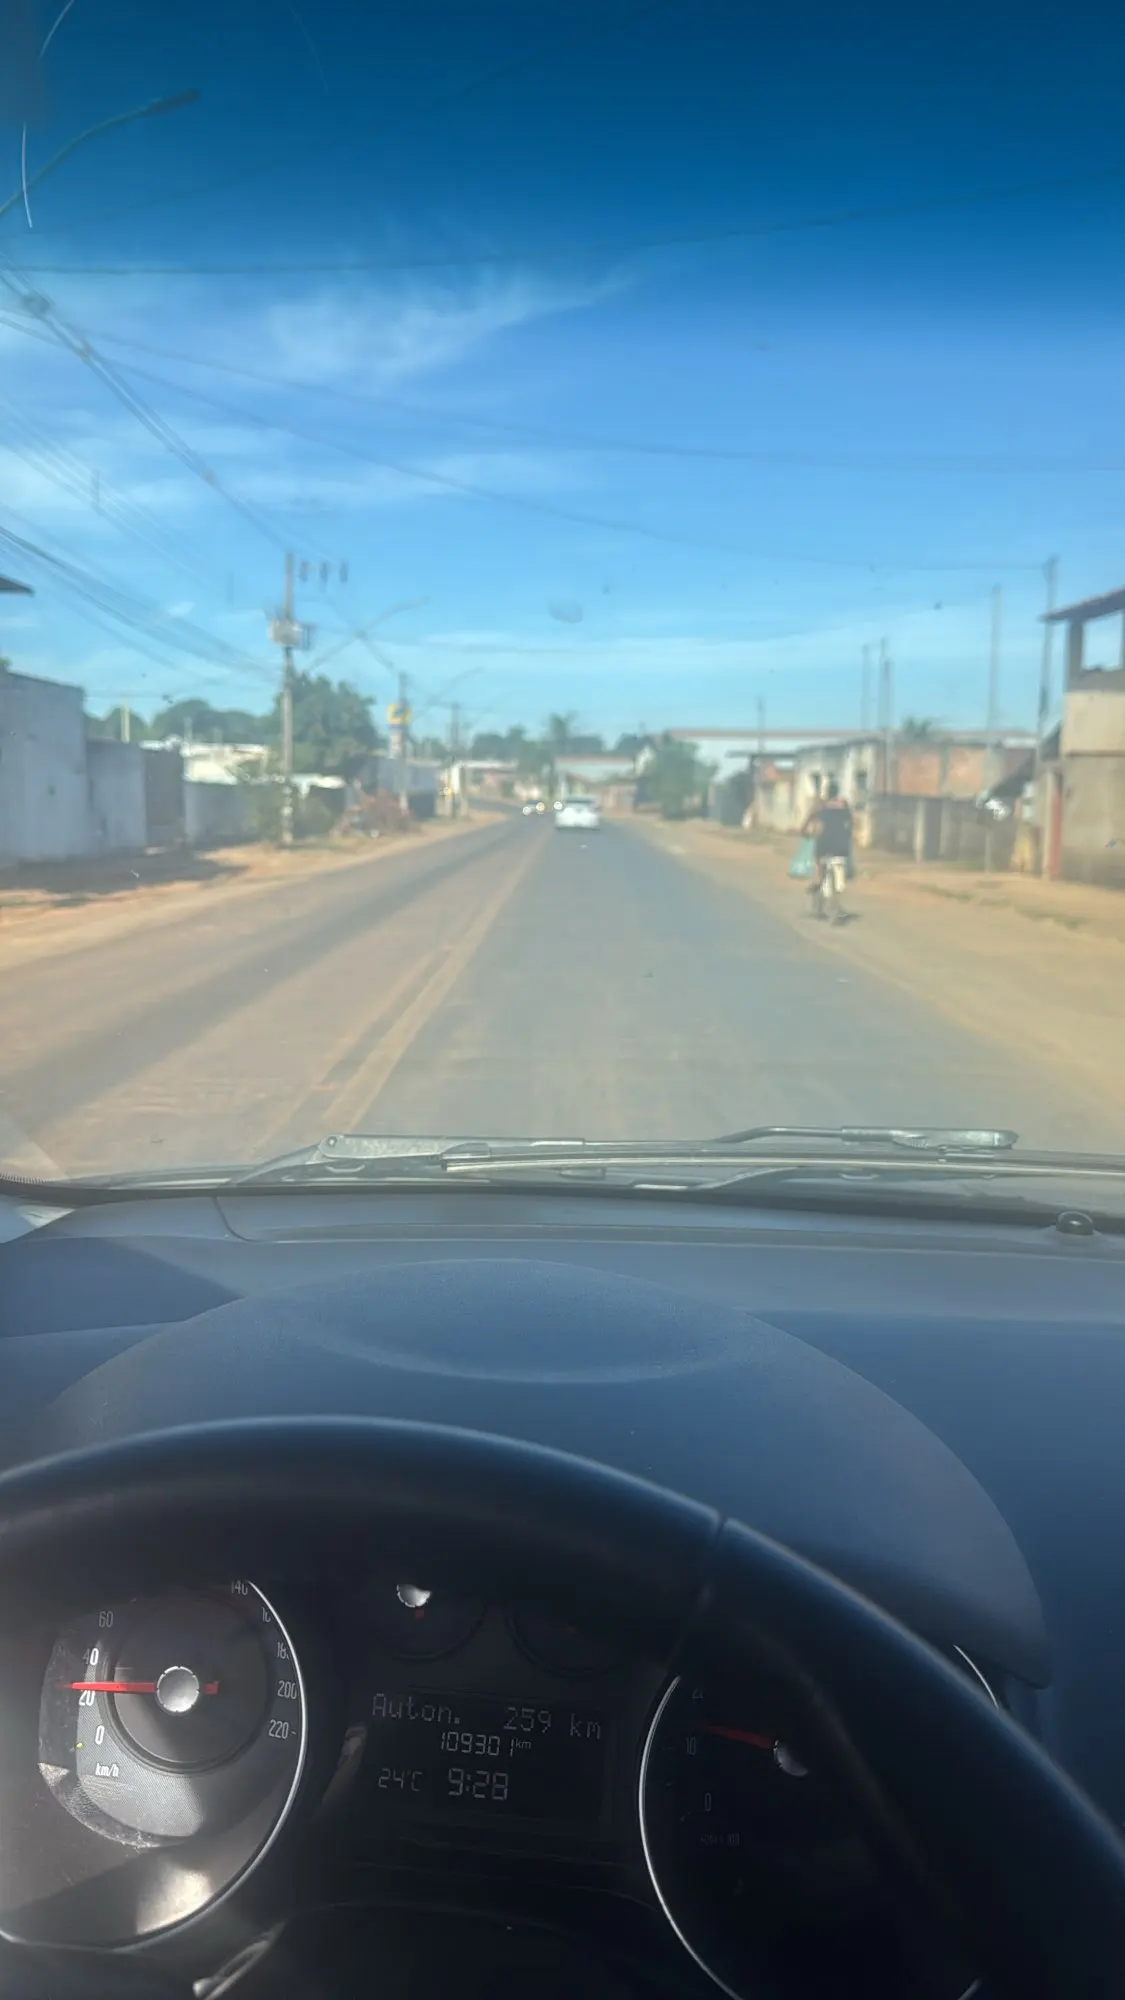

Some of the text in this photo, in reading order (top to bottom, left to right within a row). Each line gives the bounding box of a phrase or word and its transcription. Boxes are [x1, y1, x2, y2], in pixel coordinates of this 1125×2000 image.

[98, 1610, 114, 1628] 60
[82, 1647, 100, 1666] 40
[78, 1690, 96, 1706] 20
[277, 1680, 297, 1700] 200
[371, 1693, 602, 1740] Auton. 259 km
[94, 1725, 105, 1745] 0
[268, 1719, 290, 1740] 220
[685, 1736, 697, 1756] 10
[94, 1762, 120, 1778] km/h
[448, 1767, 509, 1802] 9:28
[704, 1792, 713, 1812] 0
